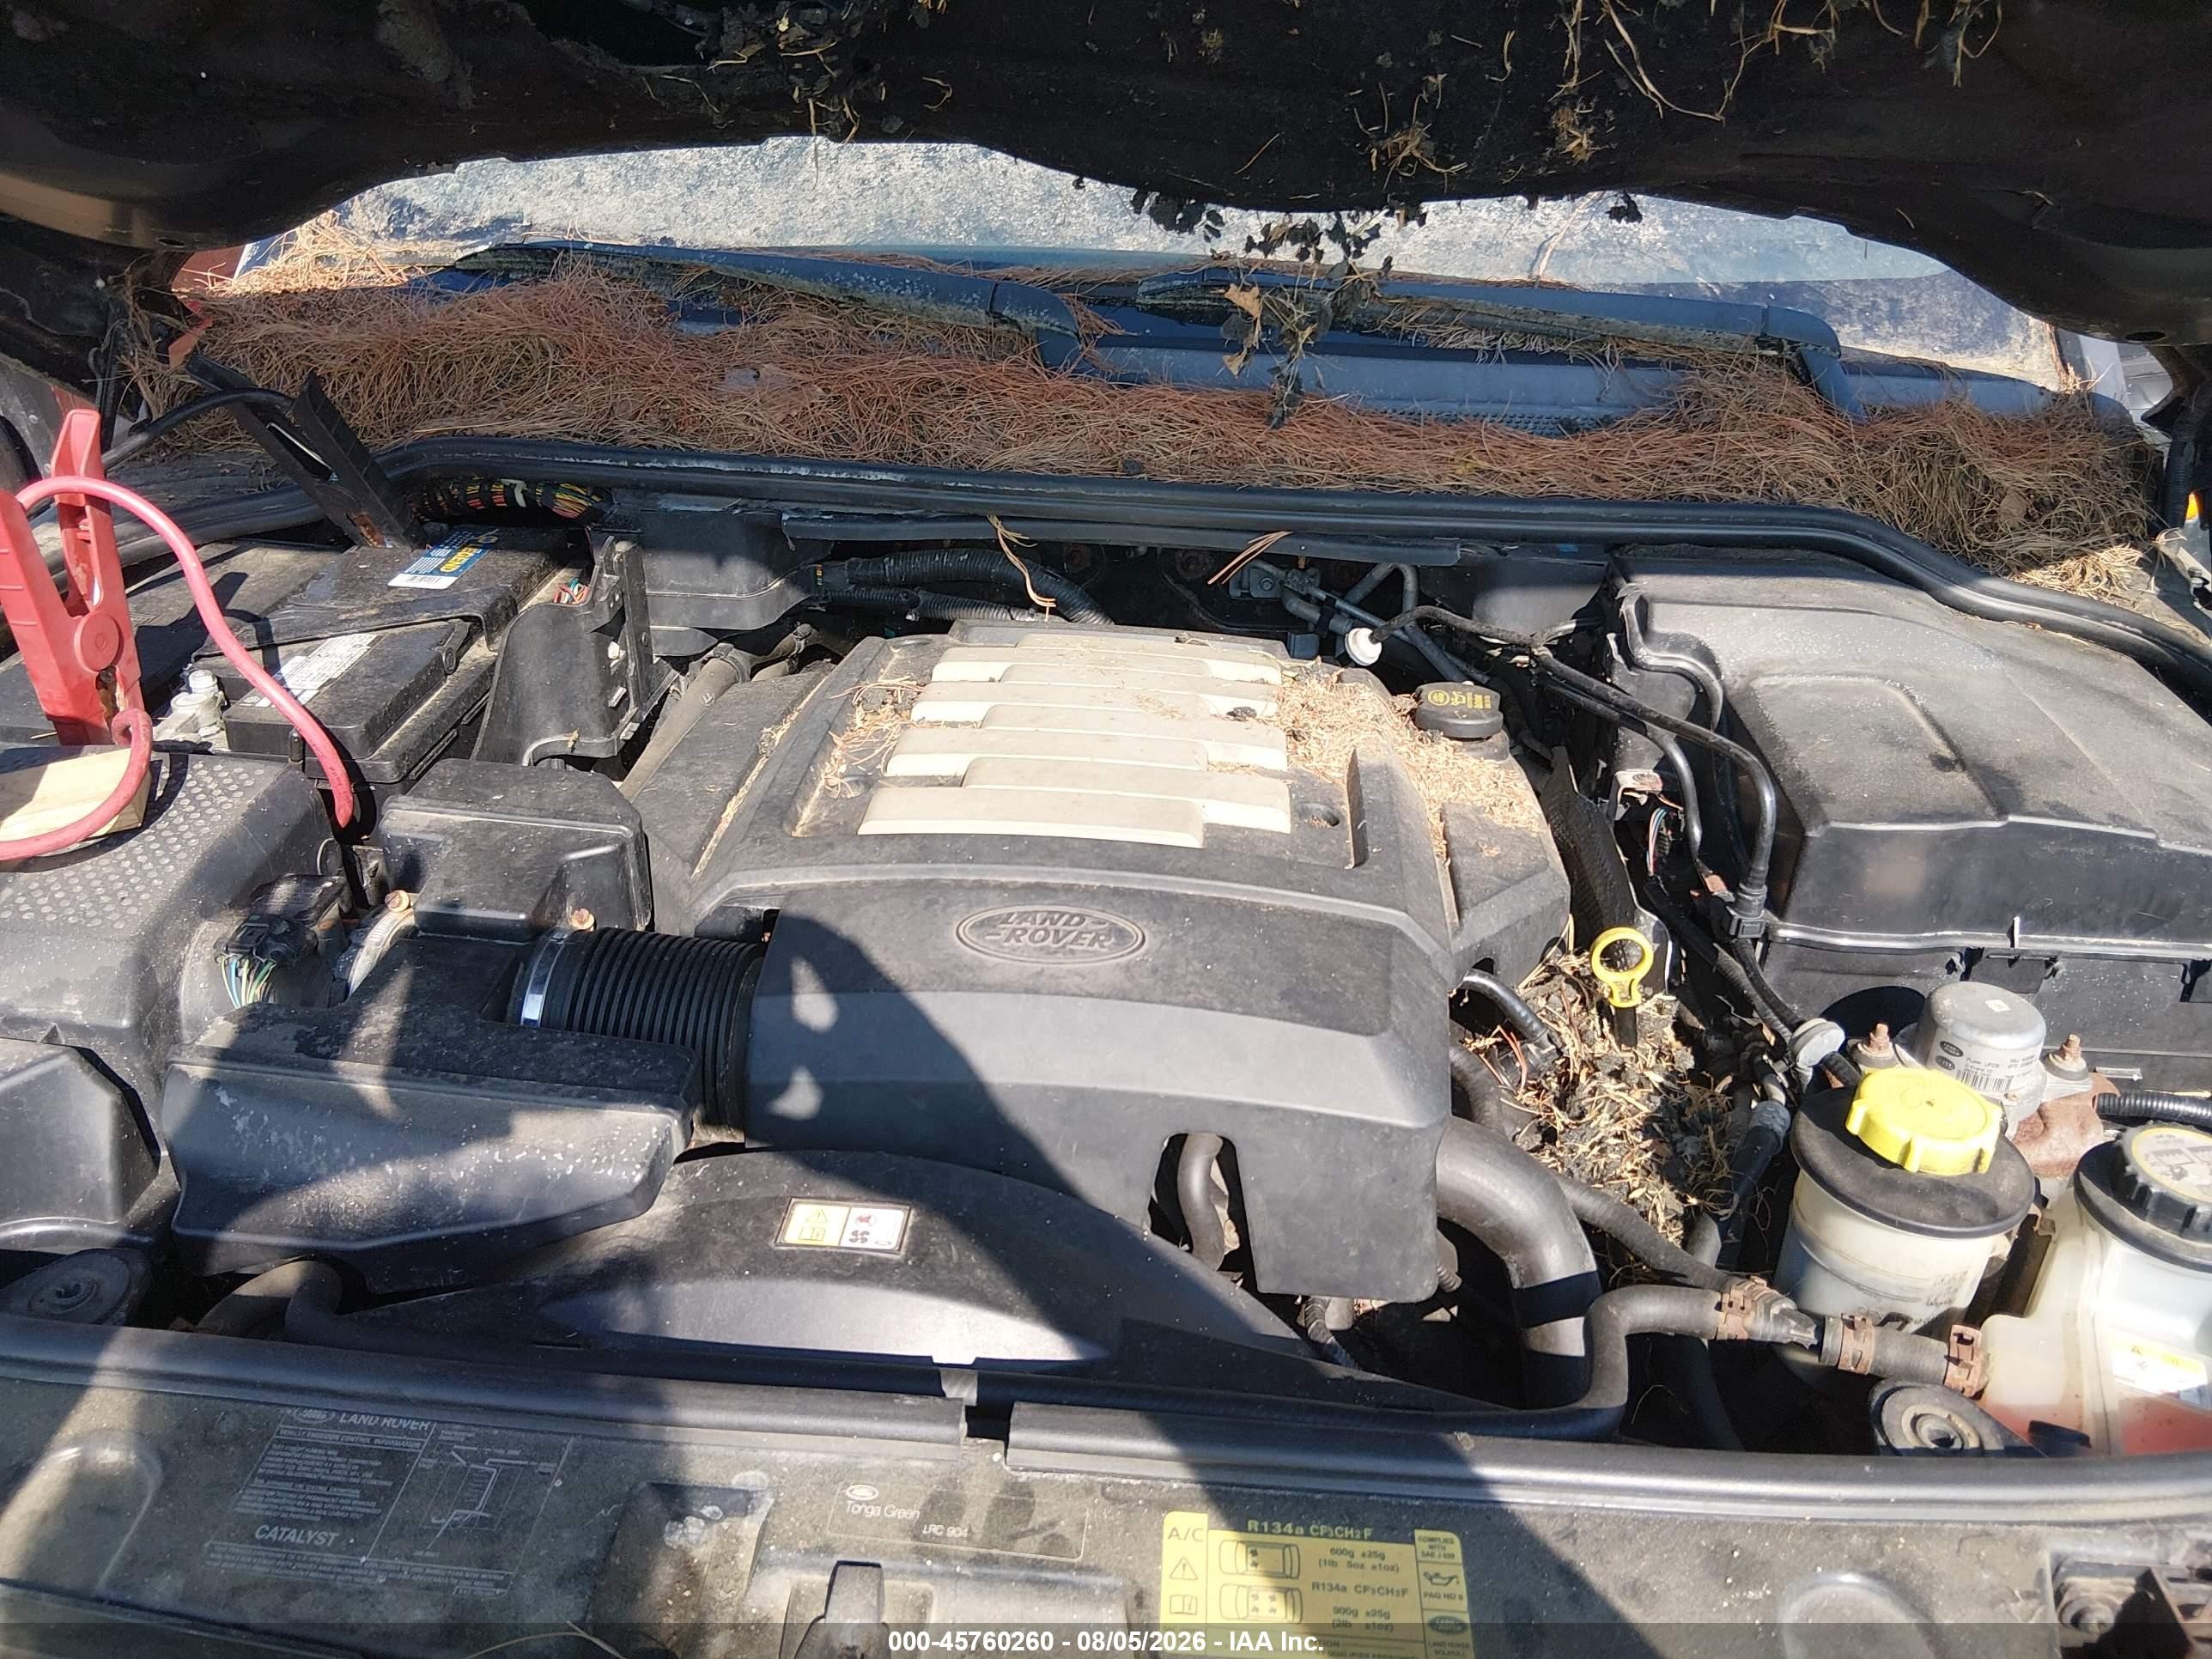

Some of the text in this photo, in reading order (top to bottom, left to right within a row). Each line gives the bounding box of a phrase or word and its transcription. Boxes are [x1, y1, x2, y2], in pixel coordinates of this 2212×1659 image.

[339, 1413, 380, 1426] LAND
[845, 1500, 920, 1520] Tonga Green
[255, 1524, 340, 1547] CATALYST
[922, 1523, 969, 1538] LRC 904
[1167, 1526, 1204, 1542] A/C
[1248, 1519, 1304, 1536] R134a
[1312, 1582, 1347, 1594] R134a
